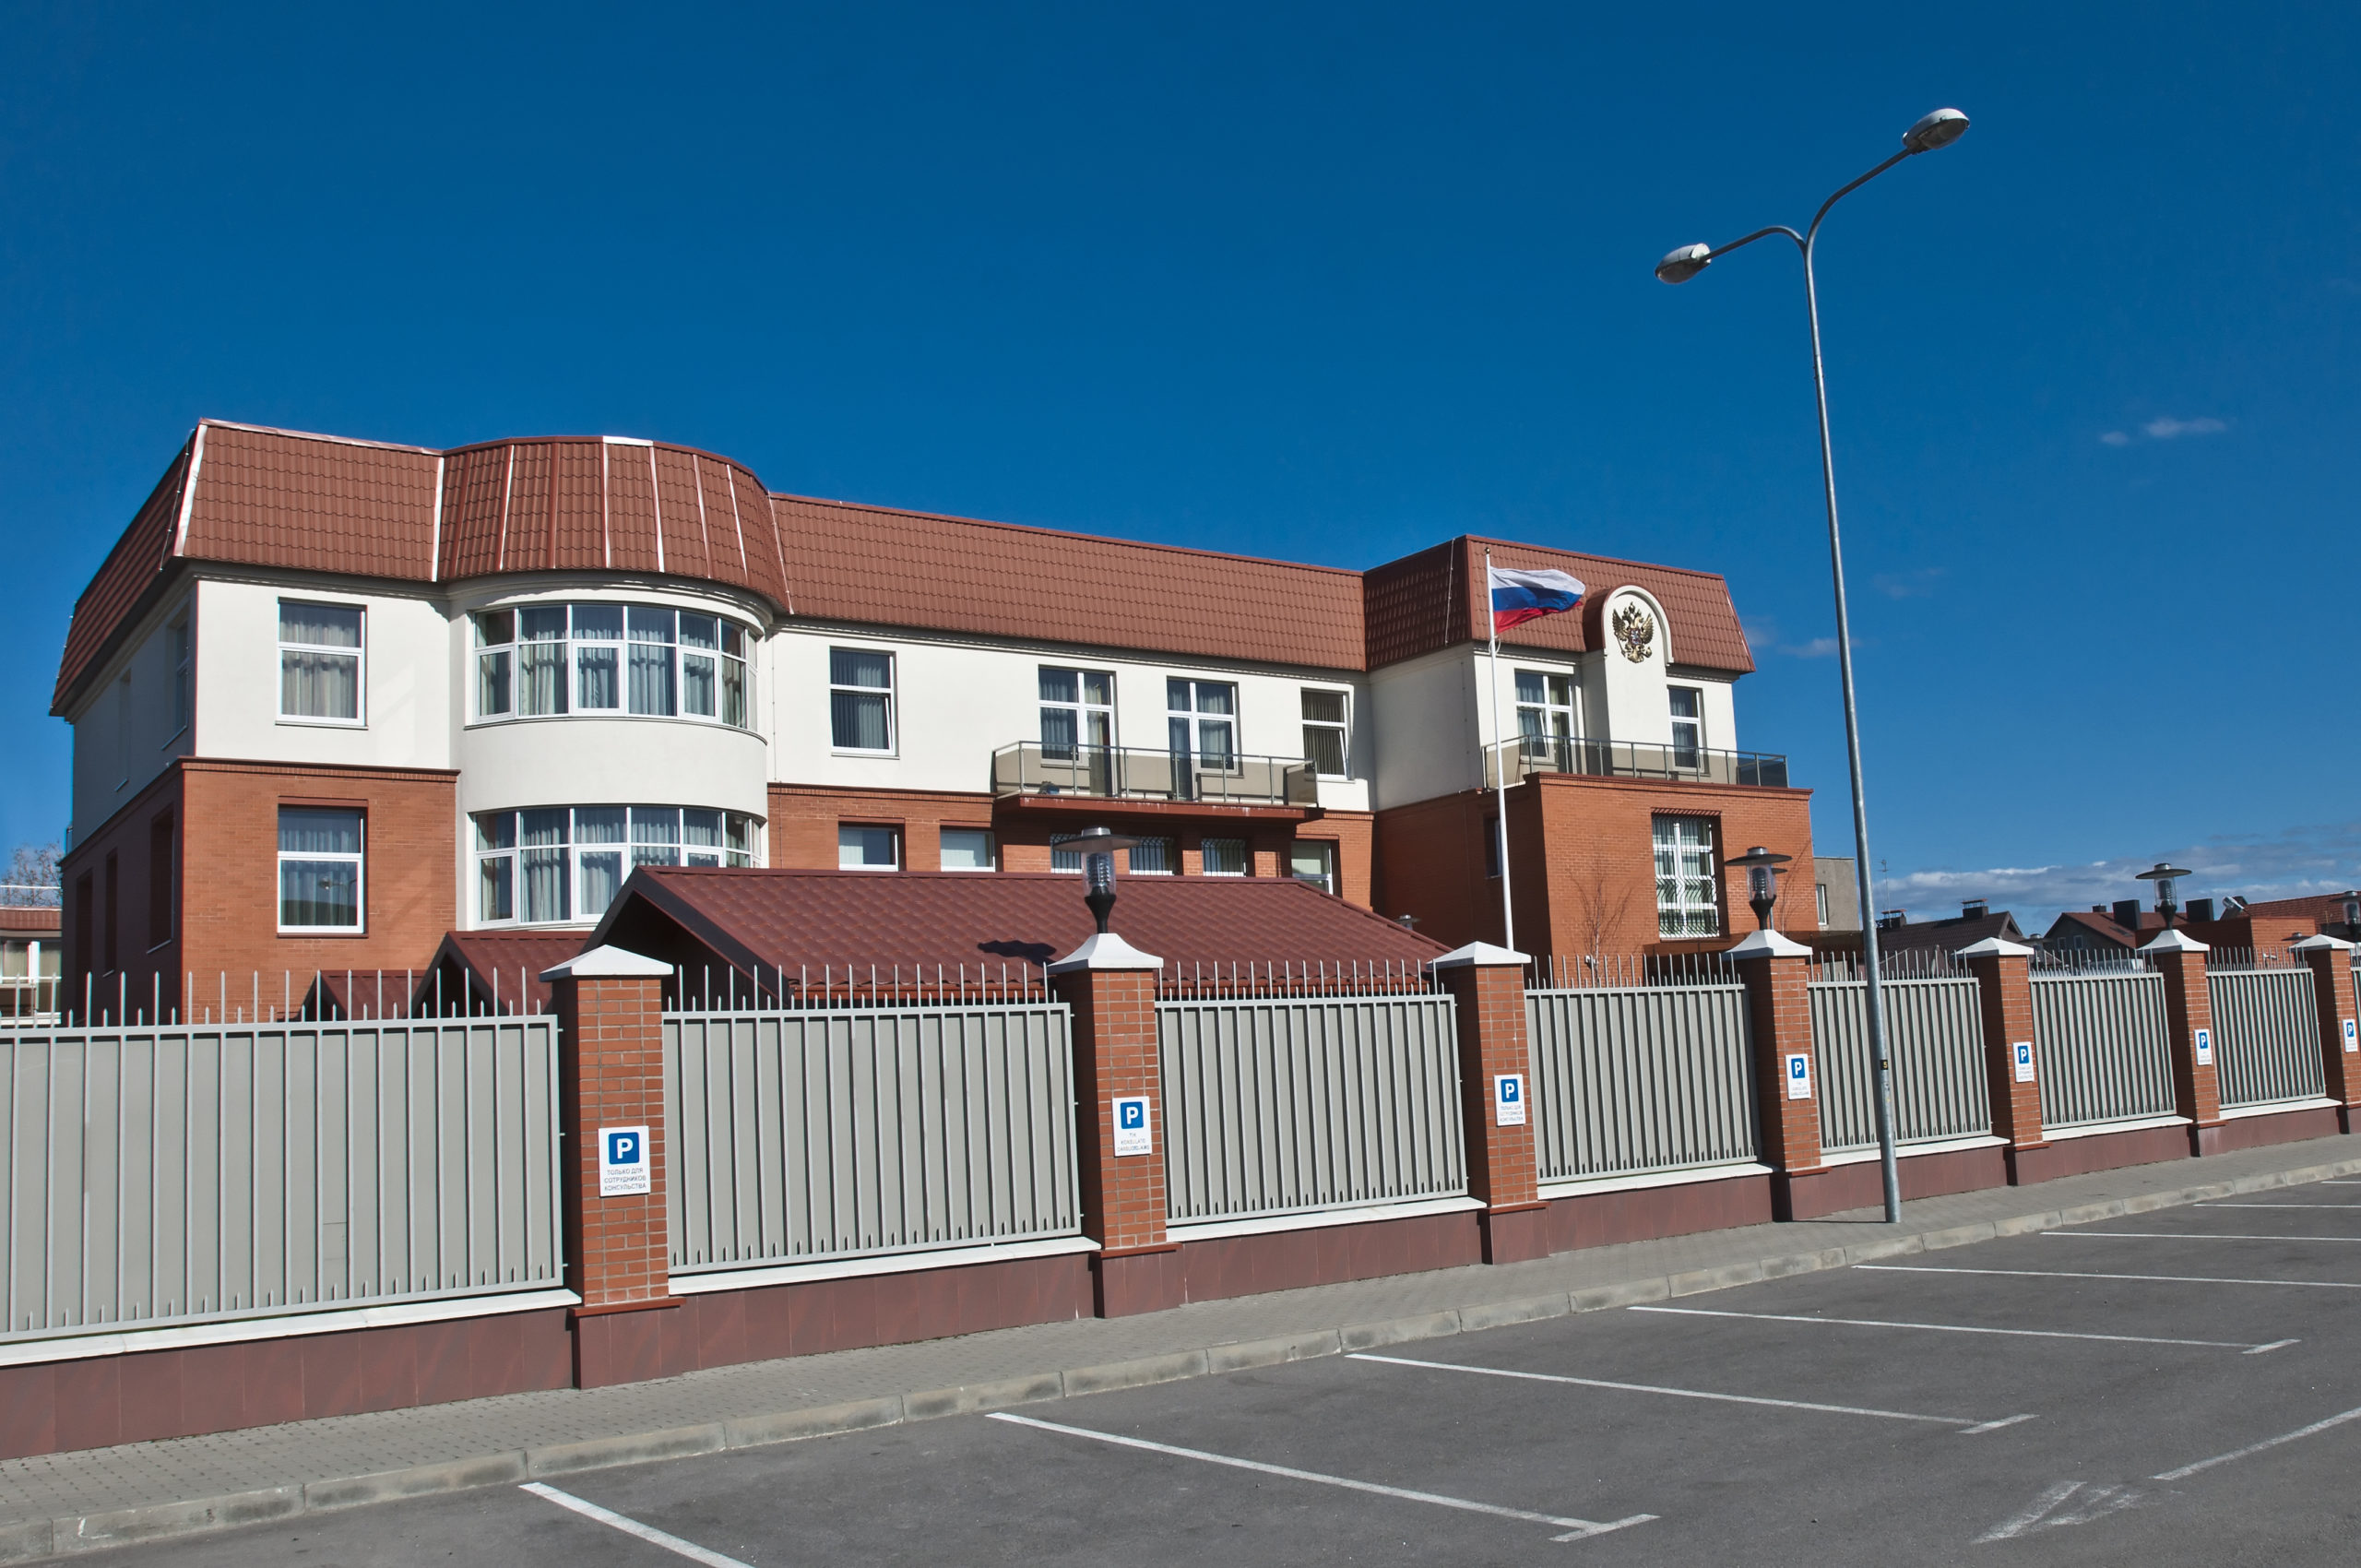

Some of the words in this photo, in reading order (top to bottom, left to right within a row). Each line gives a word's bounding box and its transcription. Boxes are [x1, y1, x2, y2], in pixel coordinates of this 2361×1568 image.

[2201, 1035, 2206, 1046] P
[2020, 1049, 2027, 1061] P
[1795, 1062, 1802, 1075] P
[1505, 1083, 1515, 1099] P
[1126, 1106, 1139, 1125] P
[617, 1137, 634, 1159] P
[607, 1168, 631, 1176] ТОЛЬКО
[631, 1167, 644, 1175] ДЛЯ
[604, 1174, 647, 1184] СОТРУДНИКОВ
[604, 1182, 647, 1192] КОНСУЛЬСТВА
